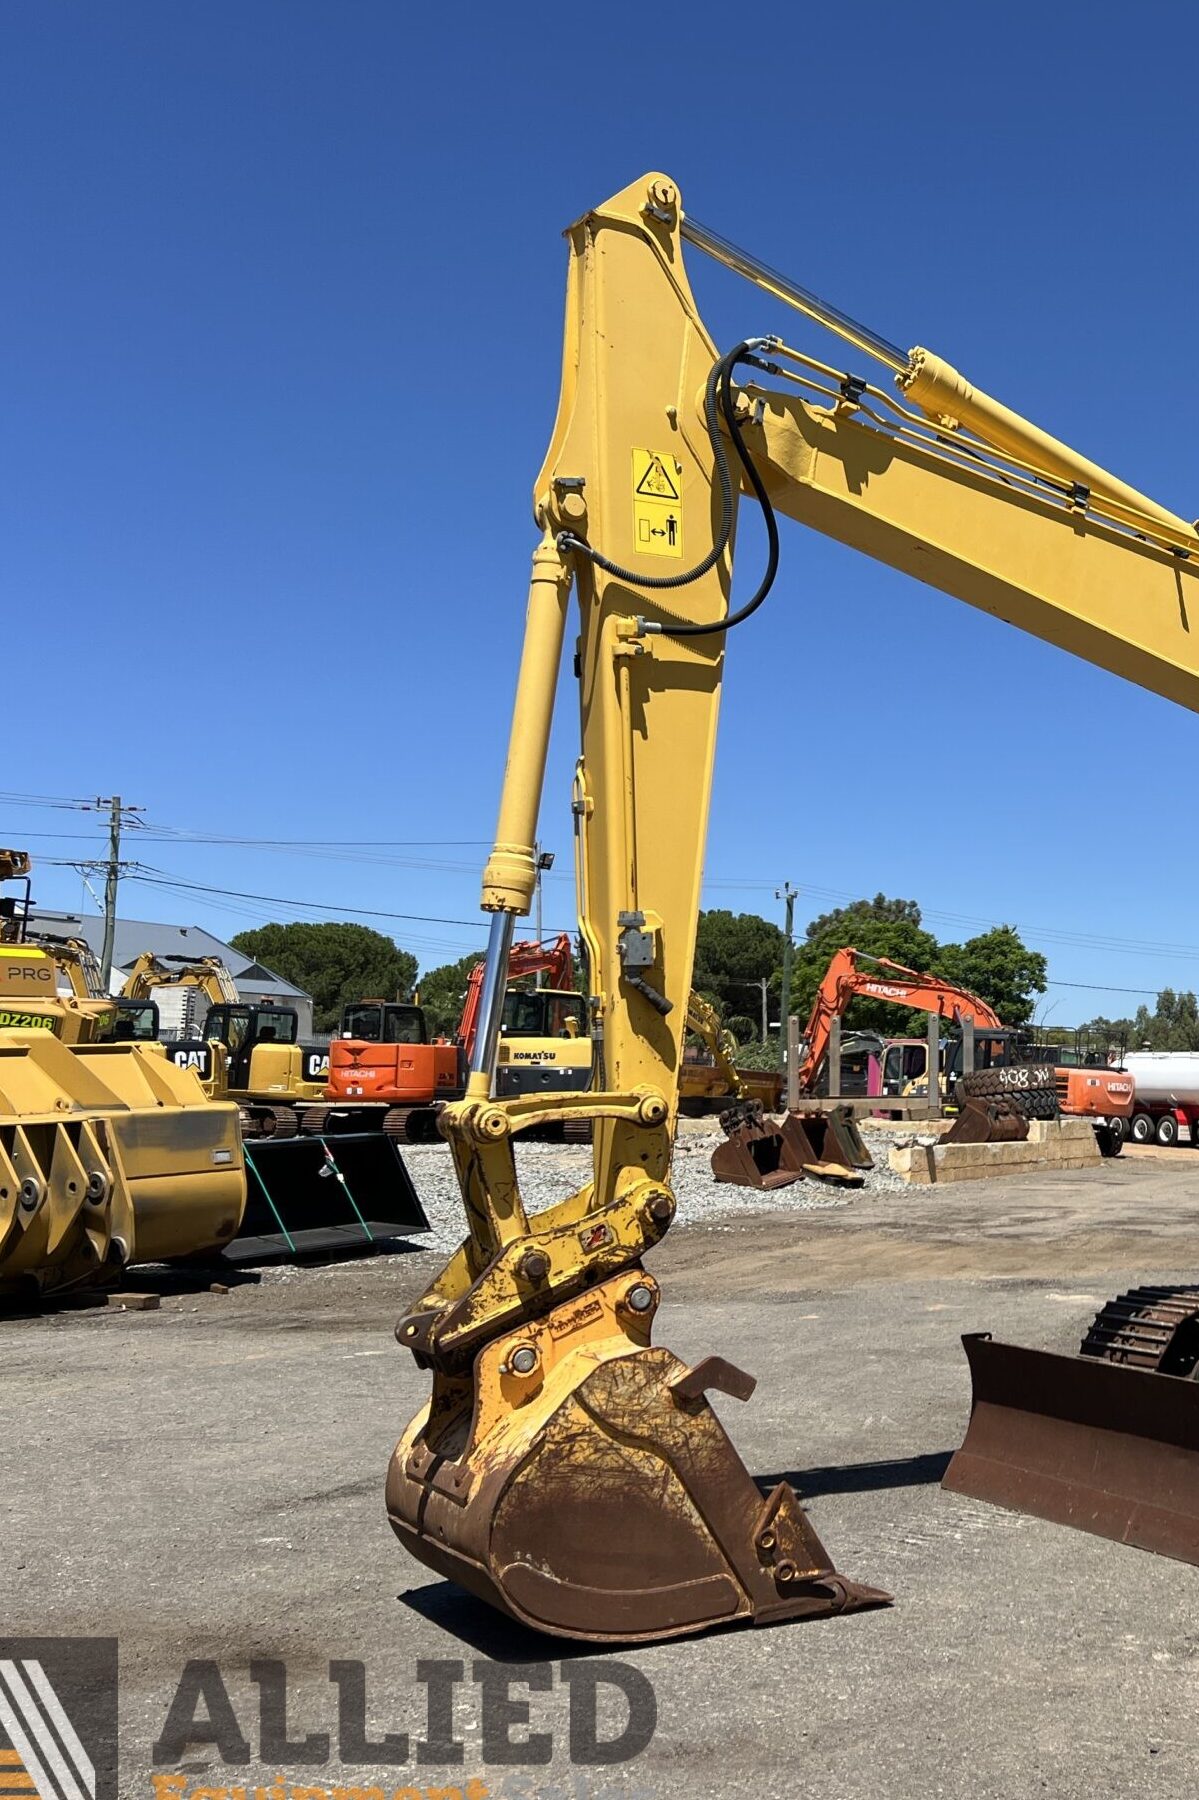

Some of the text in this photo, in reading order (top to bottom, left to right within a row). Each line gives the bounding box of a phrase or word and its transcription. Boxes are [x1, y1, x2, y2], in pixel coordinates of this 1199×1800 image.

[8, 967, 51, 981] PRG
[866, 982, 907, 998] HITACHI
[0, 1012, 53, 1030] DZ206
[174, 1051, 207, 1073] CAT
[513, 1050, 556, 1060] KOMATSU
[309, 1055, 329, 1076] CA
